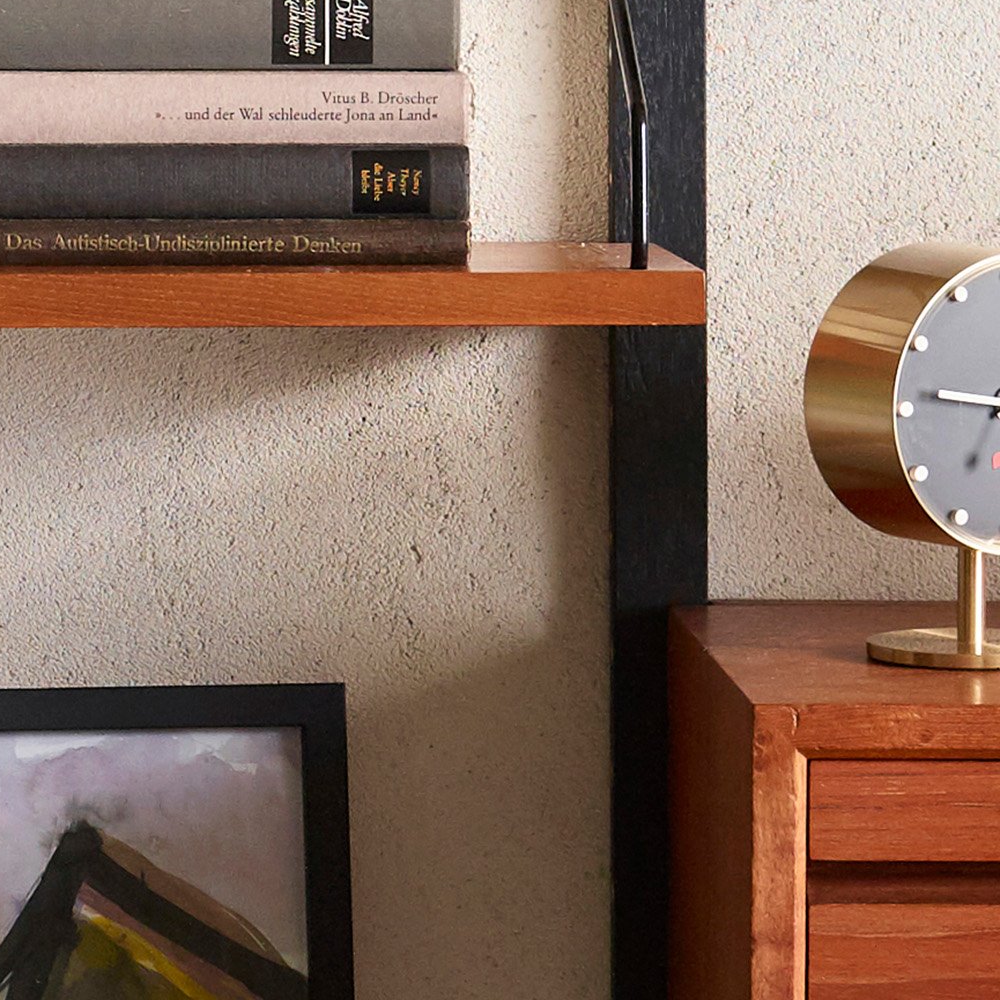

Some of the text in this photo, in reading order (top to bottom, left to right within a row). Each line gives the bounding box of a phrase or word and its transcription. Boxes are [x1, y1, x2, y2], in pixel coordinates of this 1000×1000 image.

[321, 90, 439, 105] Vitus B. Dröscher
[185, 107, 210, 121] und
[213, 107, 235, 121] der
[239, 107, 264, 121] Wal
[268, 107, 342, 121] schleuderte
[344, 107, 375, 124] Jona
[379, 112, 394, 121] an
[5, 233, 43, 250] Das
[291, 235, 362, 254] Denken
